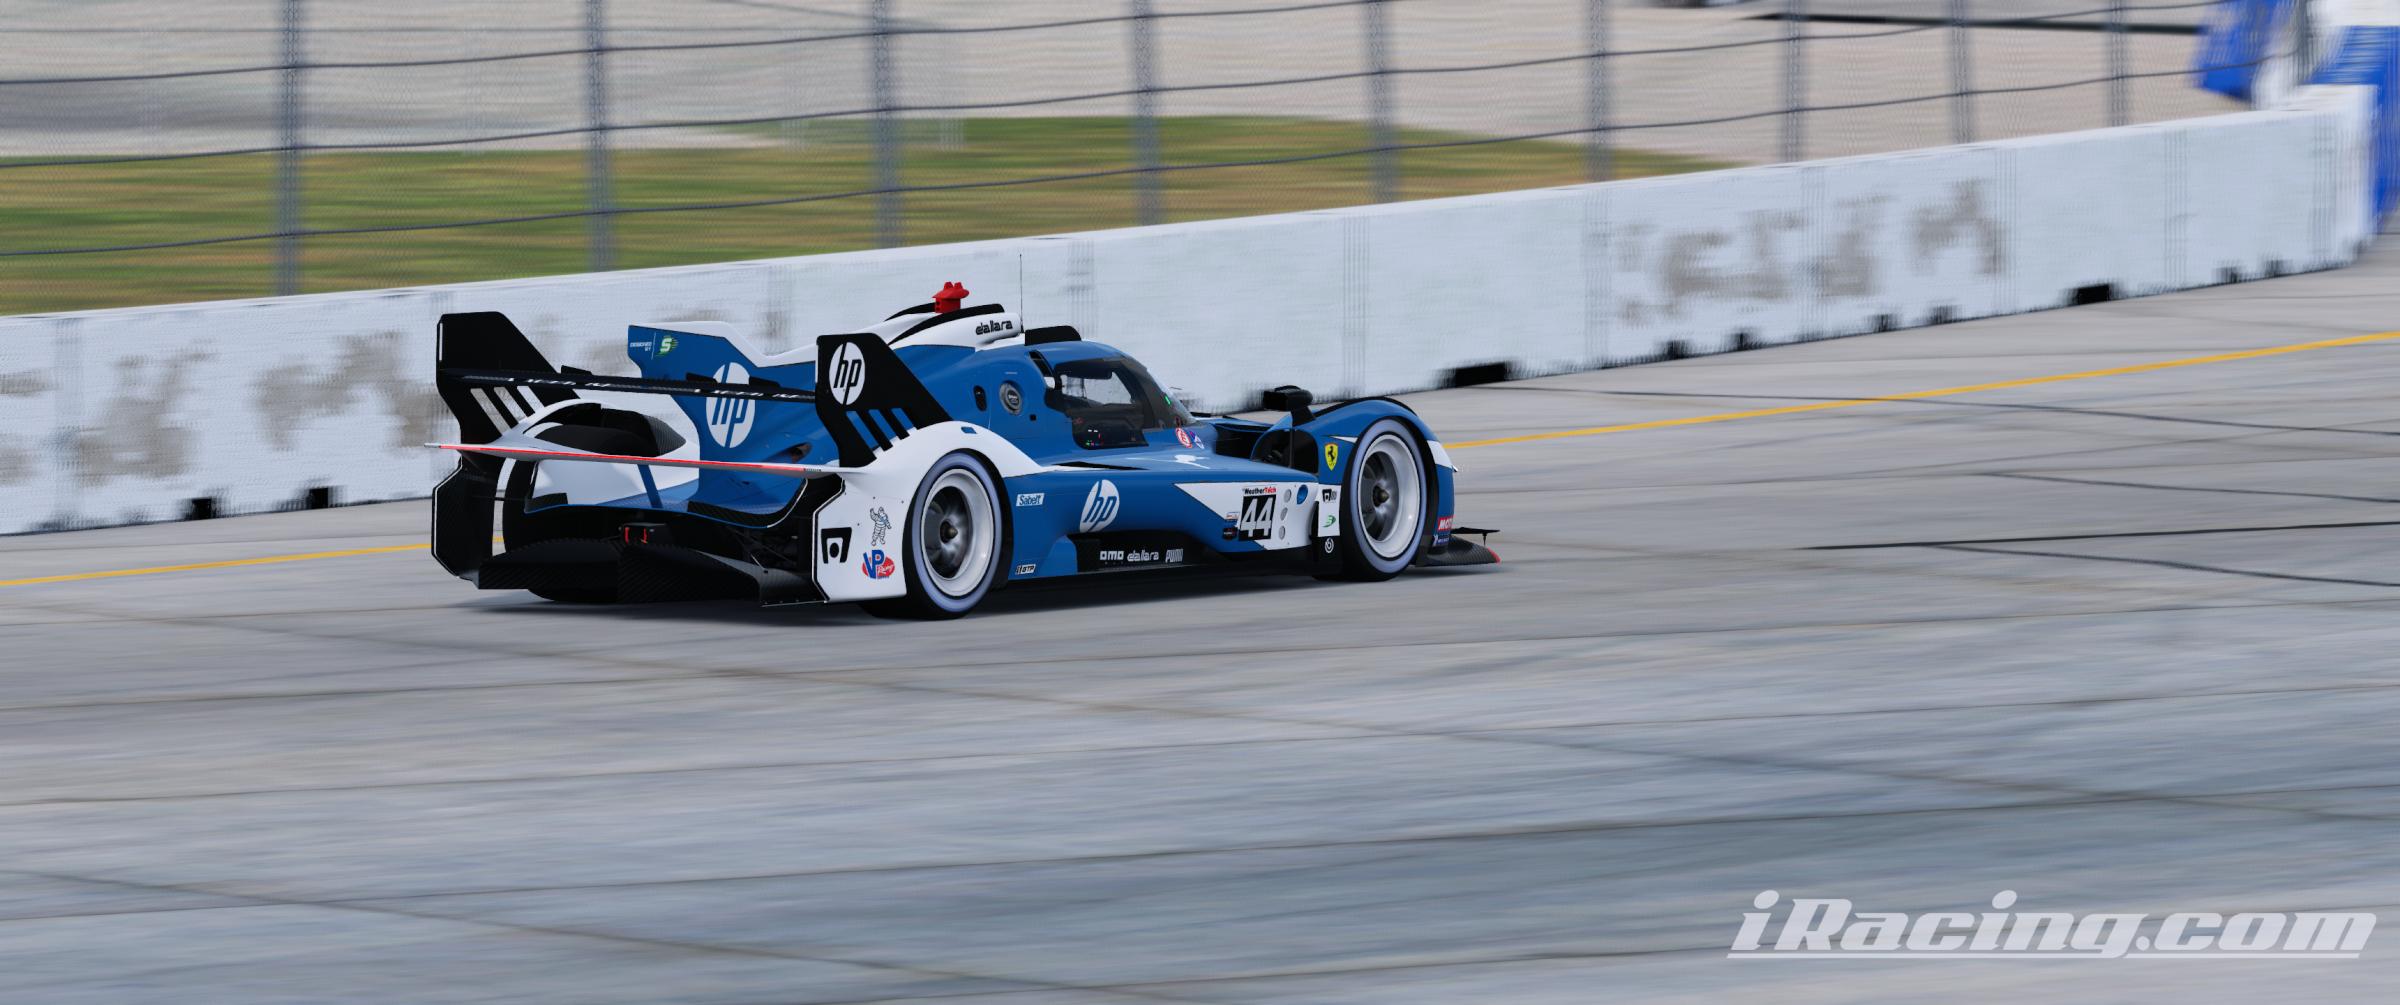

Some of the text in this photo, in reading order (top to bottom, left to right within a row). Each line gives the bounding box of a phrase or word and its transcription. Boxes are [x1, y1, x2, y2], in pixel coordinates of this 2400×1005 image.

[975, 320, 1013, 335] dallara
[833, 343, 862, 405] hp
[711, 362, 750, 448] hp
[1082, 480, 1118, 532] hp
[1240, 497, 1273, 538] 44
[863, 549, 885, 579] VP
[1127, 549, 1160, 562] dallara
